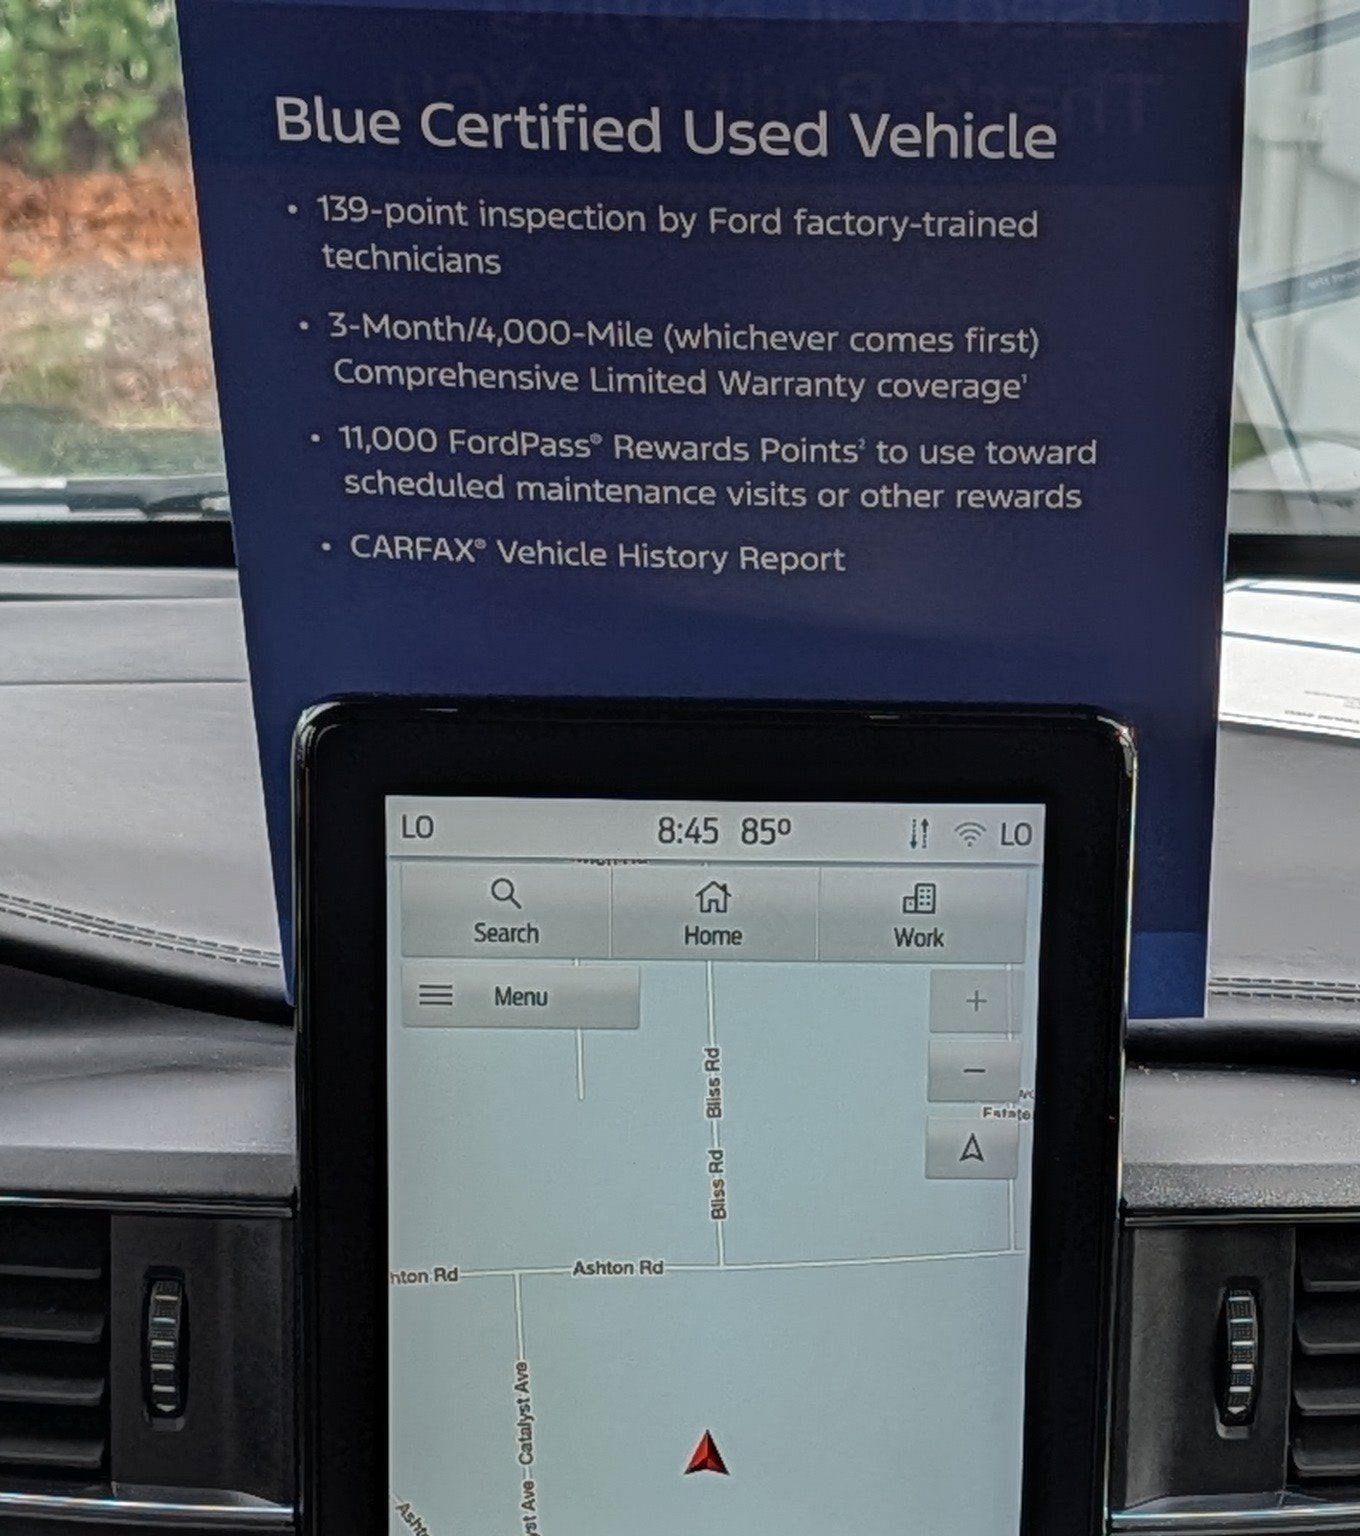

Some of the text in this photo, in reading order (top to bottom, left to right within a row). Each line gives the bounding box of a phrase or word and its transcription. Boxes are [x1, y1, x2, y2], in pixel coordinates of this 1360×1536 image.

[276, 96, 401, 145] Blue
[421, 102, 662, 153] Certified
[684, 109, 829, 157] Used
[850, 111, 1057, 160] Vehicle
[317, 195, 1039, 242] 139-point inspection by Ford factory-trained
[322, 243, 502, 275] technicians
[328, 311, 1040, 359] 3-Month/4,000-Mile (whichever comes first)
[334, 357, 579, 392] Comprehensive
[590, 365, 707, 395] Limited
[717, 370, 866, 403] Warranty
[338, 424, 438, 455] 11,000
[614, 433, 749, 462] Rewards
[876, 440, 909, 465] to
[920, 444, 976, 466] use
[986, 439, 1098, 466] toward
[344, 470, 1082, 509] scheduled maintenance visits or other rewards
[496, 539, 608, 568] Vehicle
[618, 543, 729, 575] History
[739, 546, 846, 575] Report
[402, 814, 434, 839] LO
[658, 816, 719, 844] 8:45
[1001, 821, 1033, 846] LO
[474, 922, 540, 944] Search
[684, 925, 743, 947] Home
[894, 926, 944, 948] Work
[494, 986, 549, 1008] Menu
[704, 1047, 722, 1118] Bliss Rd
[708, 1149, 727, 1219] Bliss Rd
[434, 1267, 459, 1282] Rd
[573, 1259, 664, 1276] Ashton Rd
[515, 1362, 535, 1465] Catalyst Ave
[521, 1480, 536, 1512] Ave
